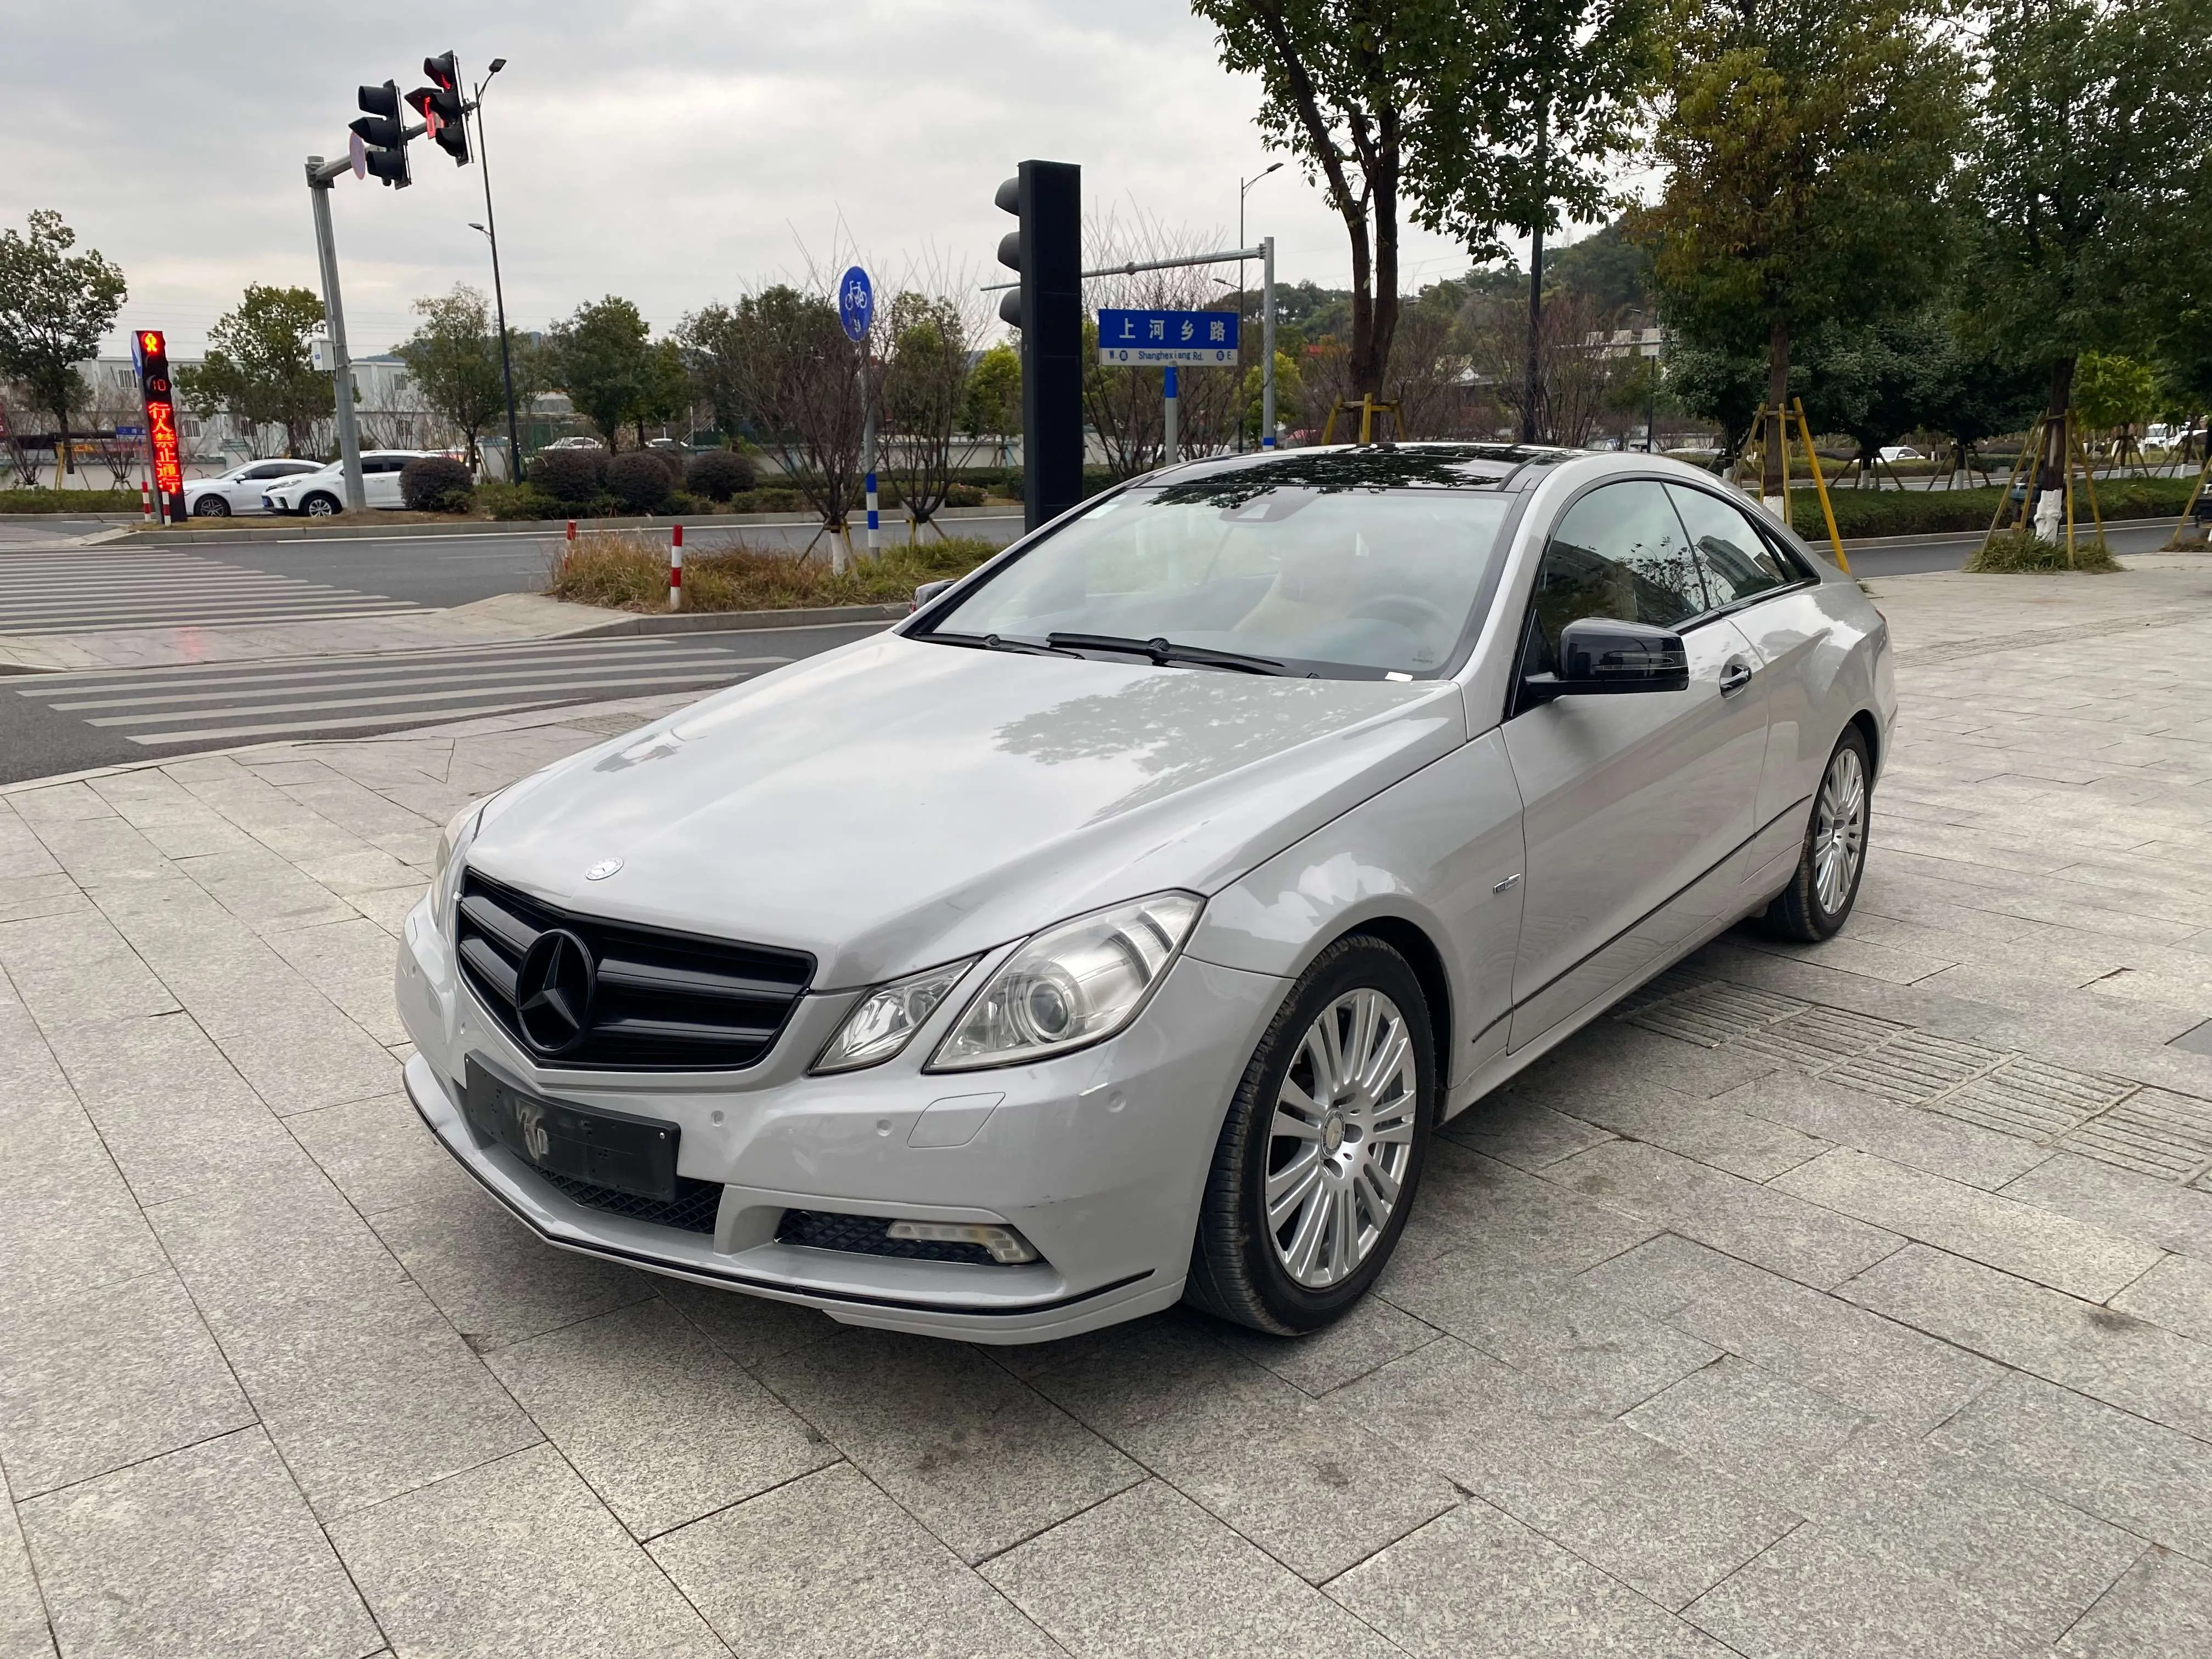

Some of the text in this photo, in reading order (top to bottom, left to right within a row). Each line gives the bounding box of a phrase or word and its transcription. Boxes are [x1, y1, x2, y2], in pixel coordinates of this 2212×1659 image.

[1119, 318, 1225, 341] 上河乡路
[1138, 350, 1204, 360] Shanghexiang Rd.
[154, 379, 166, 391] 10
[149, 402, 180, 493] 行人禁止通行
